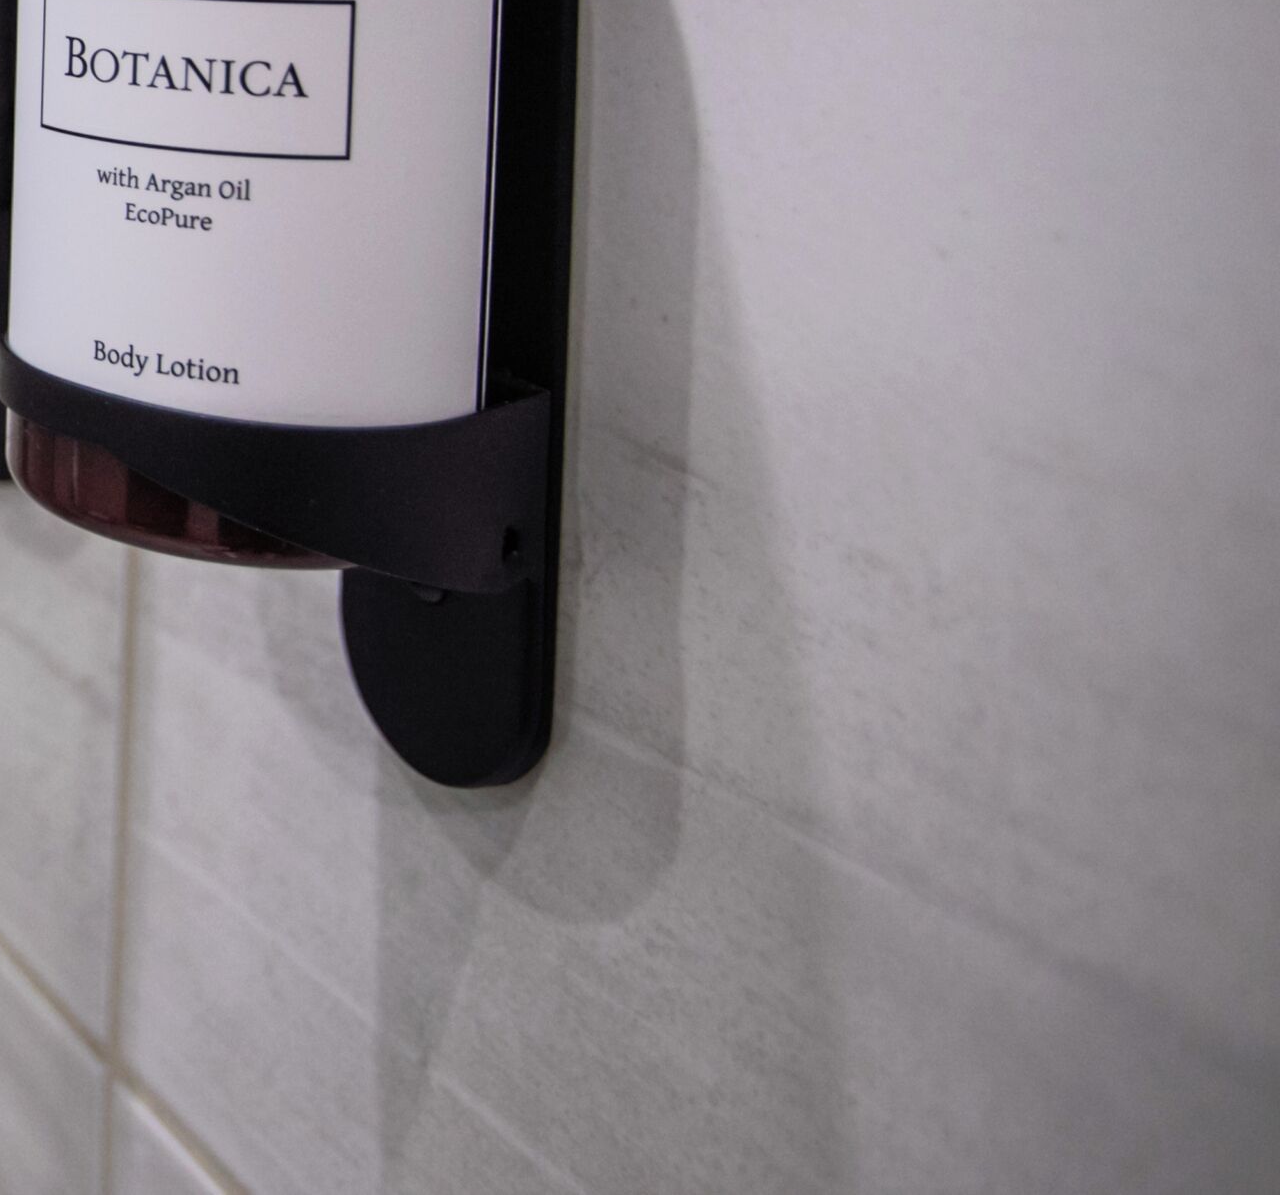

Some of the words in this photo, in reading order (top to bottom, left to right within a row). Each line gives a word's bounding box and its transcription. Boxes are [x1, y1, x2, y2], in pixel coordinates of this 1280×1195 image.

[63, 35, 309, 99] BOTANICA
[96, 166, 140, 190] with
[145, 172, 212, 202] Argan
[218, 178, 251, 202] Oil
[124, 202, 213, 232] EcoPure
[93, 339, 150, 377] Body
[155, 352, 240, 386] Lotion
